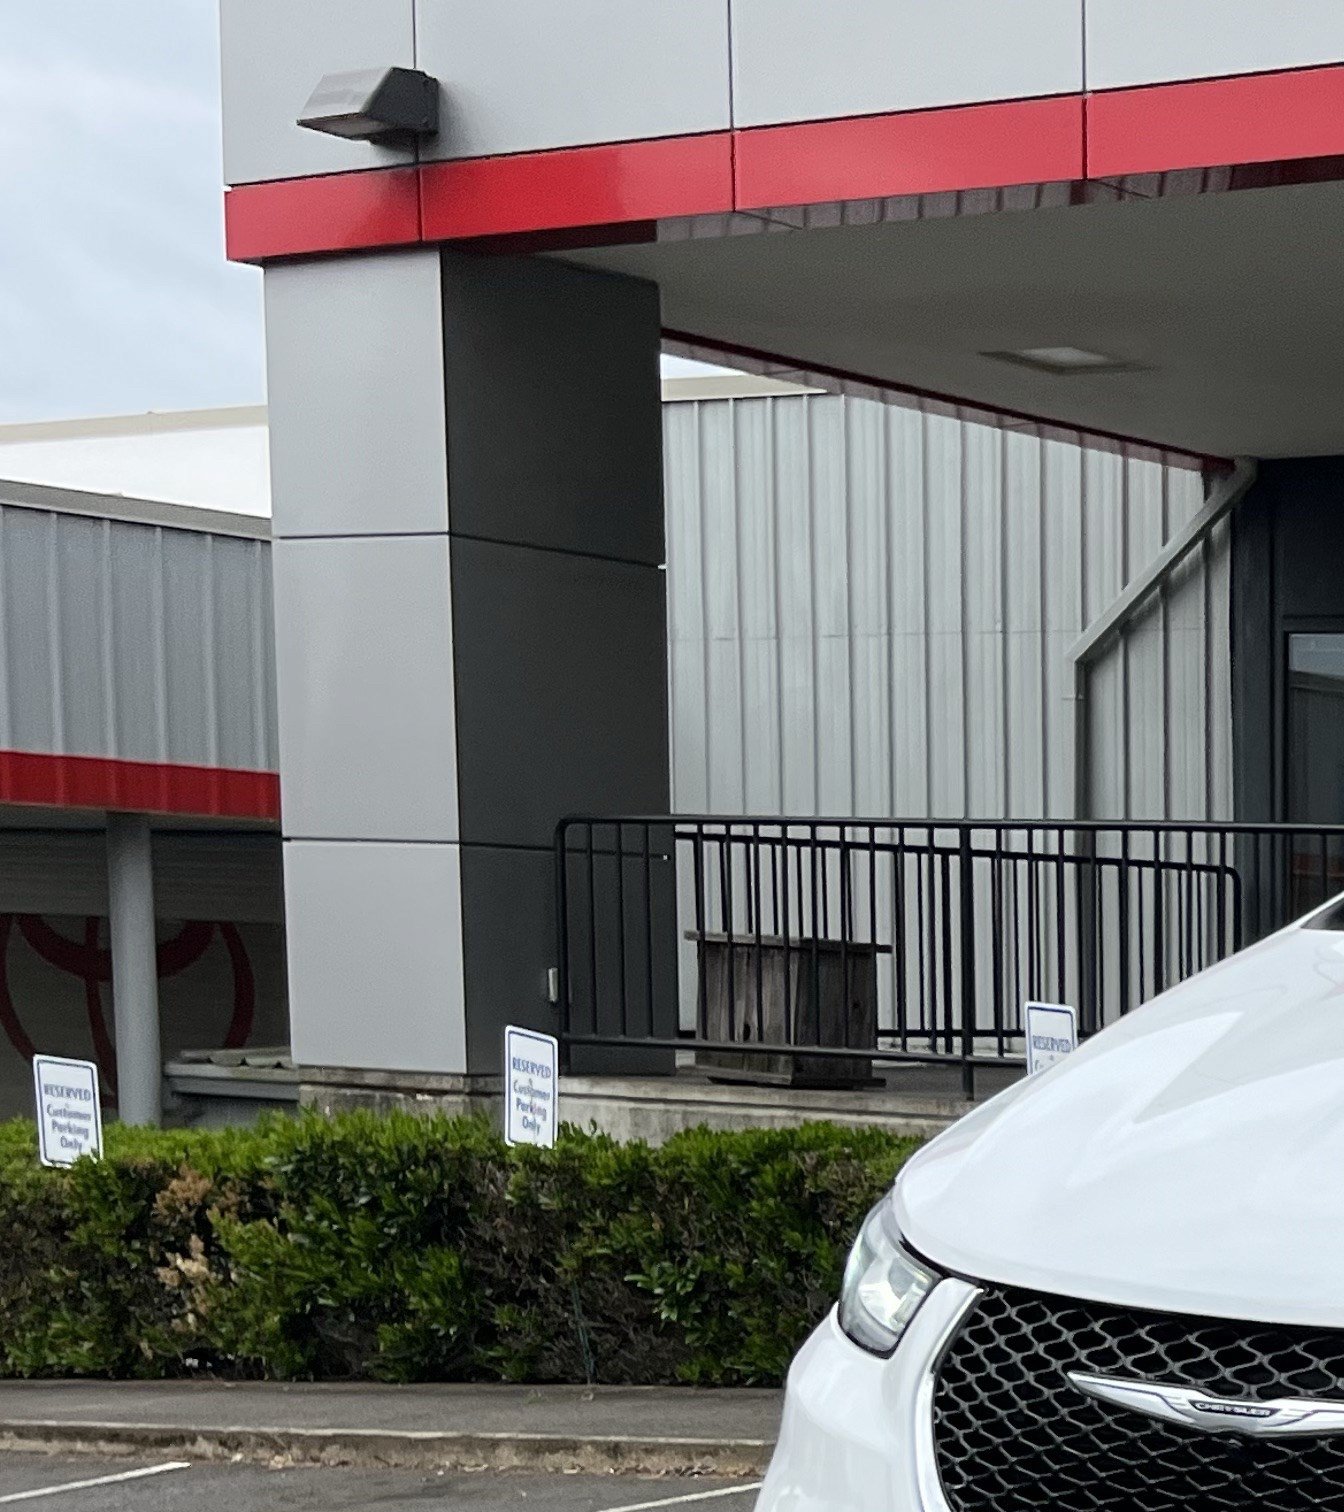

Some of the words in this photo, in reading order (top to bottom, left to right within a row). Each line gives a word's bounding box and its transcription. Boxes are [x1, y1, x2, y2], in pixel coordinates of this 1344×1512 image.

[1032, 1035, 1072, 1053] RESERVED
[512, 1057, 552, 1078] RESERVED
[43, 1083, 91, 1102] RESERVED
[513, 1080, 551, 1101] Customer
[46, 1104, 91, 1121] Customer
[516, 1098, 547, 1122] Parking
[52, 1120, 90, 1141] Parking
[522, 1116, 541, 1136] Only
[60, 1135, 83, 1154] Only
[1194, 1401, 1272, 1417] CHRYSLER
